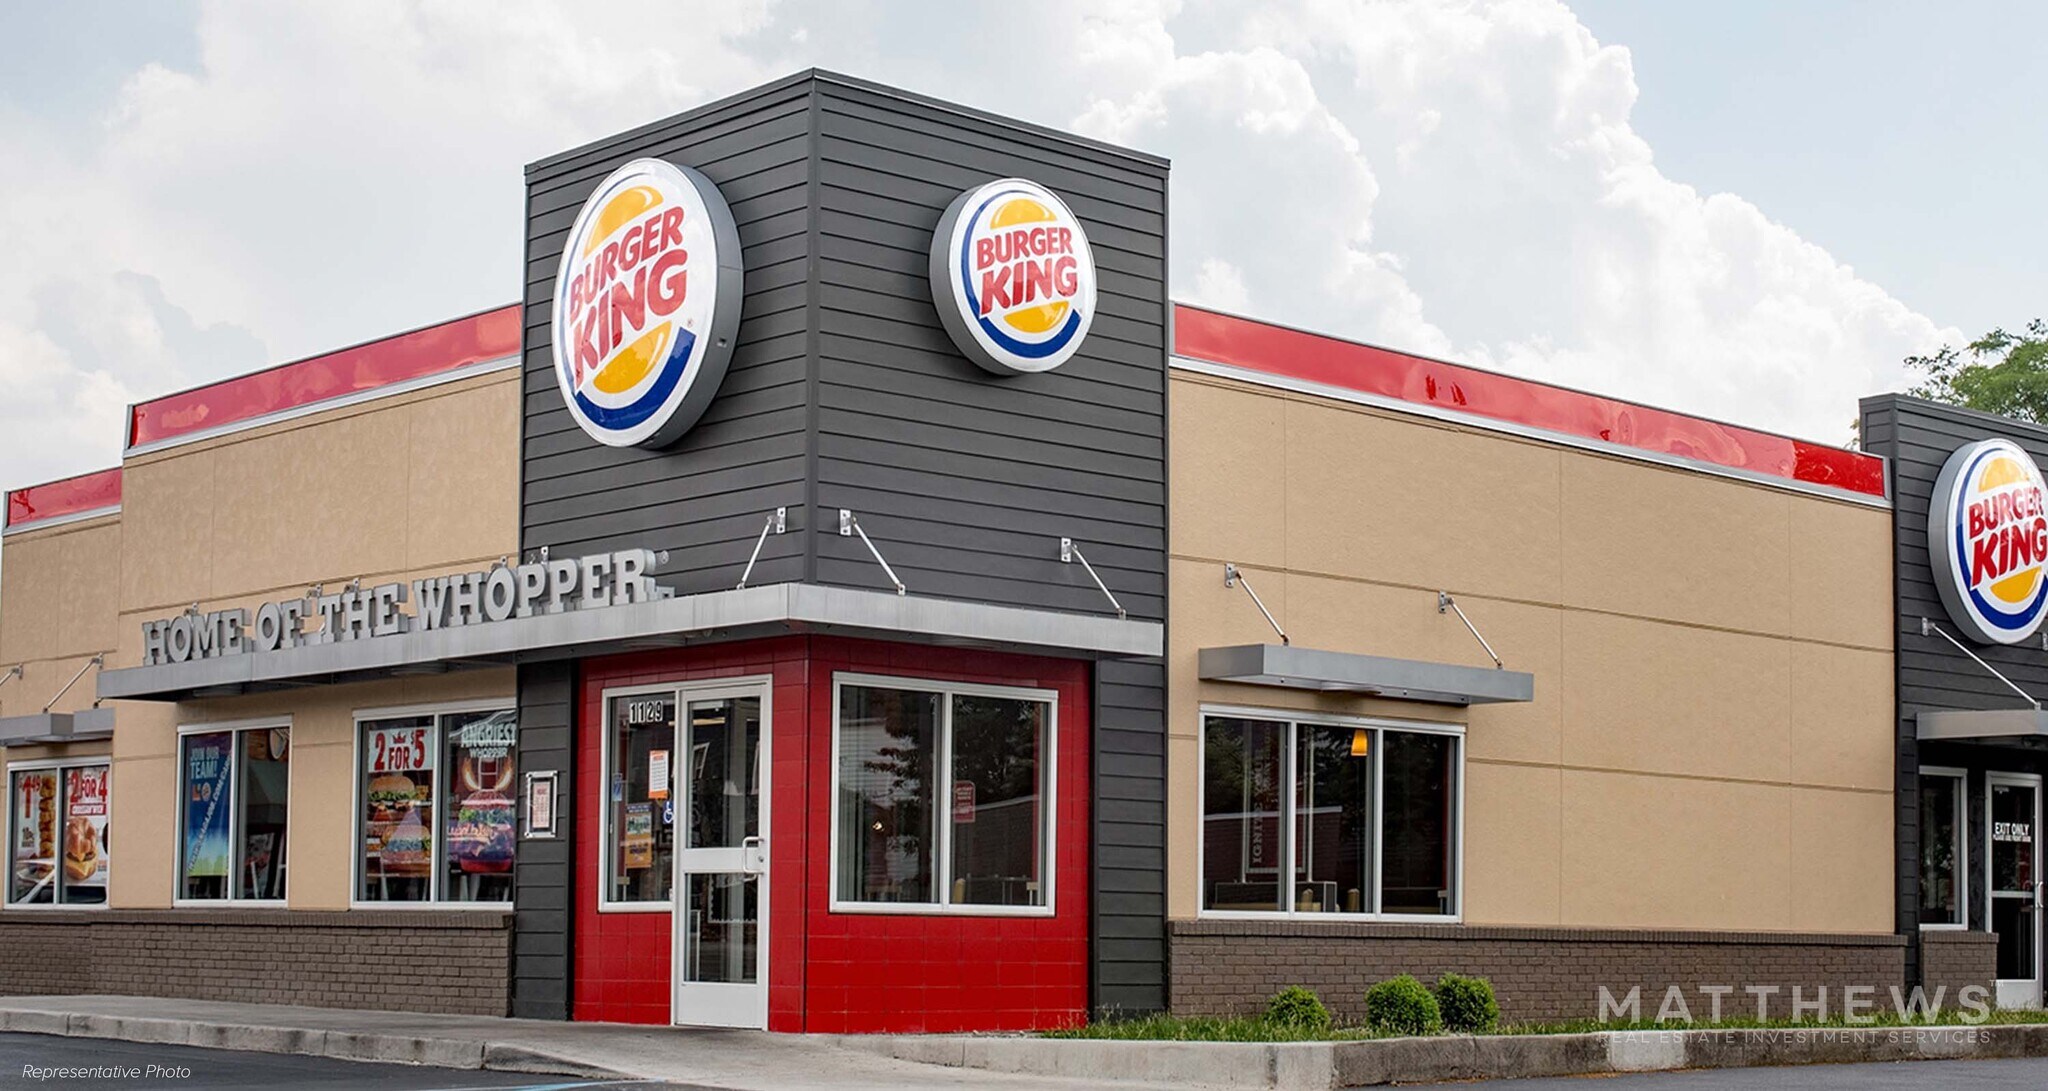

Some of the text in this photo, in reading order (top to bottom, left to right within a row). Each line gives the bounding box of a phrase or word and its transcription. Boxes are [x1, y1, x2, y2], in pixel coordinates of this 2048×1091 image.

[570, 206, 685, 325] BURGER
[977, 227, 1073, 270] BURGER
[981, 255, 1077, 316] KING
[572, 249, 688, 390] KING
[1968, 486, 2044, 540] BURGER
[1971, 517, 2048, 587] KING
[142, 548, 655, 667] HOME OF THE WHOPPER
[630, 700, 663, 723] 1129
[190, 760, 218, 780] TEAM!
[374, 732, 386, 771] 2
[388, 746, 411, 770] FOR
[81, 778, 97, 798] FOR
[1995, 822, 2030, 836] EXIT ONLY
